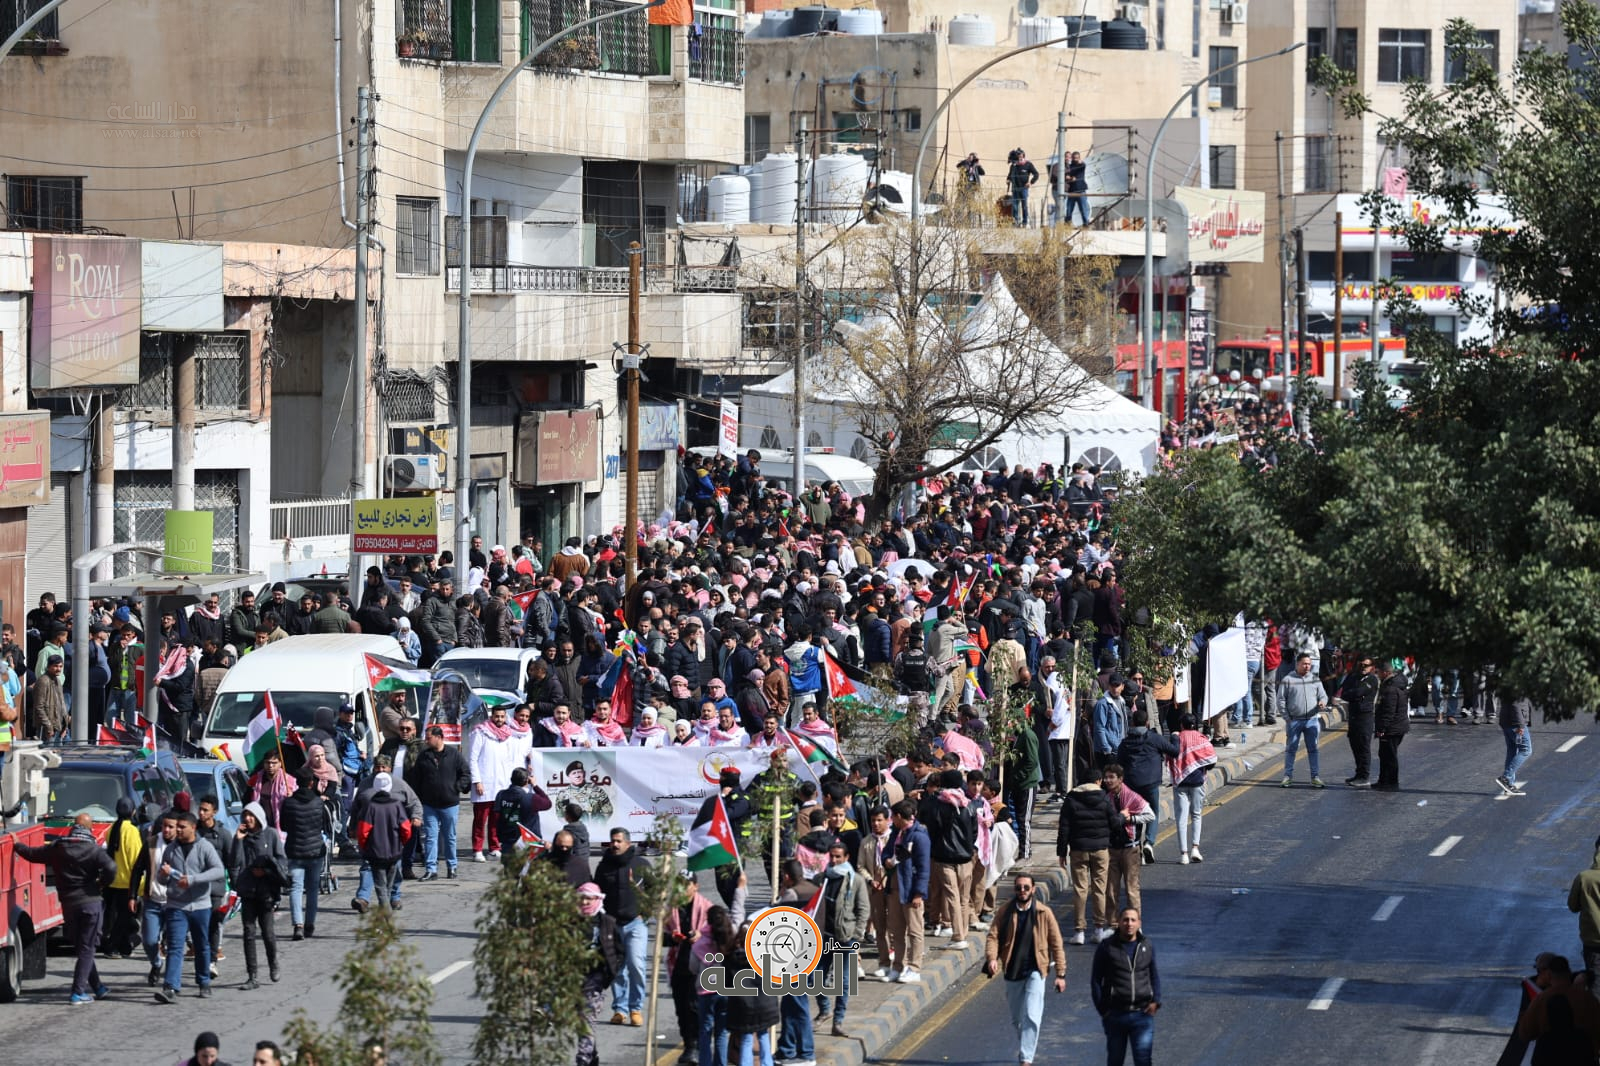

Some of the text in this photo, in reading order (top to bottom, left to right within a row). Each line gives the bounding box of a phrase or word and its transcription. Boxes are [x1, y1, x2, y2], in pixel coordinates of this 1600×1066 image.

[68, 252, 124, 319] ROYAL
[357, 507, 380, 529] للبيع
[382, 508, 411, 528] تجاري
[413, 507, 434, 528] أرض
